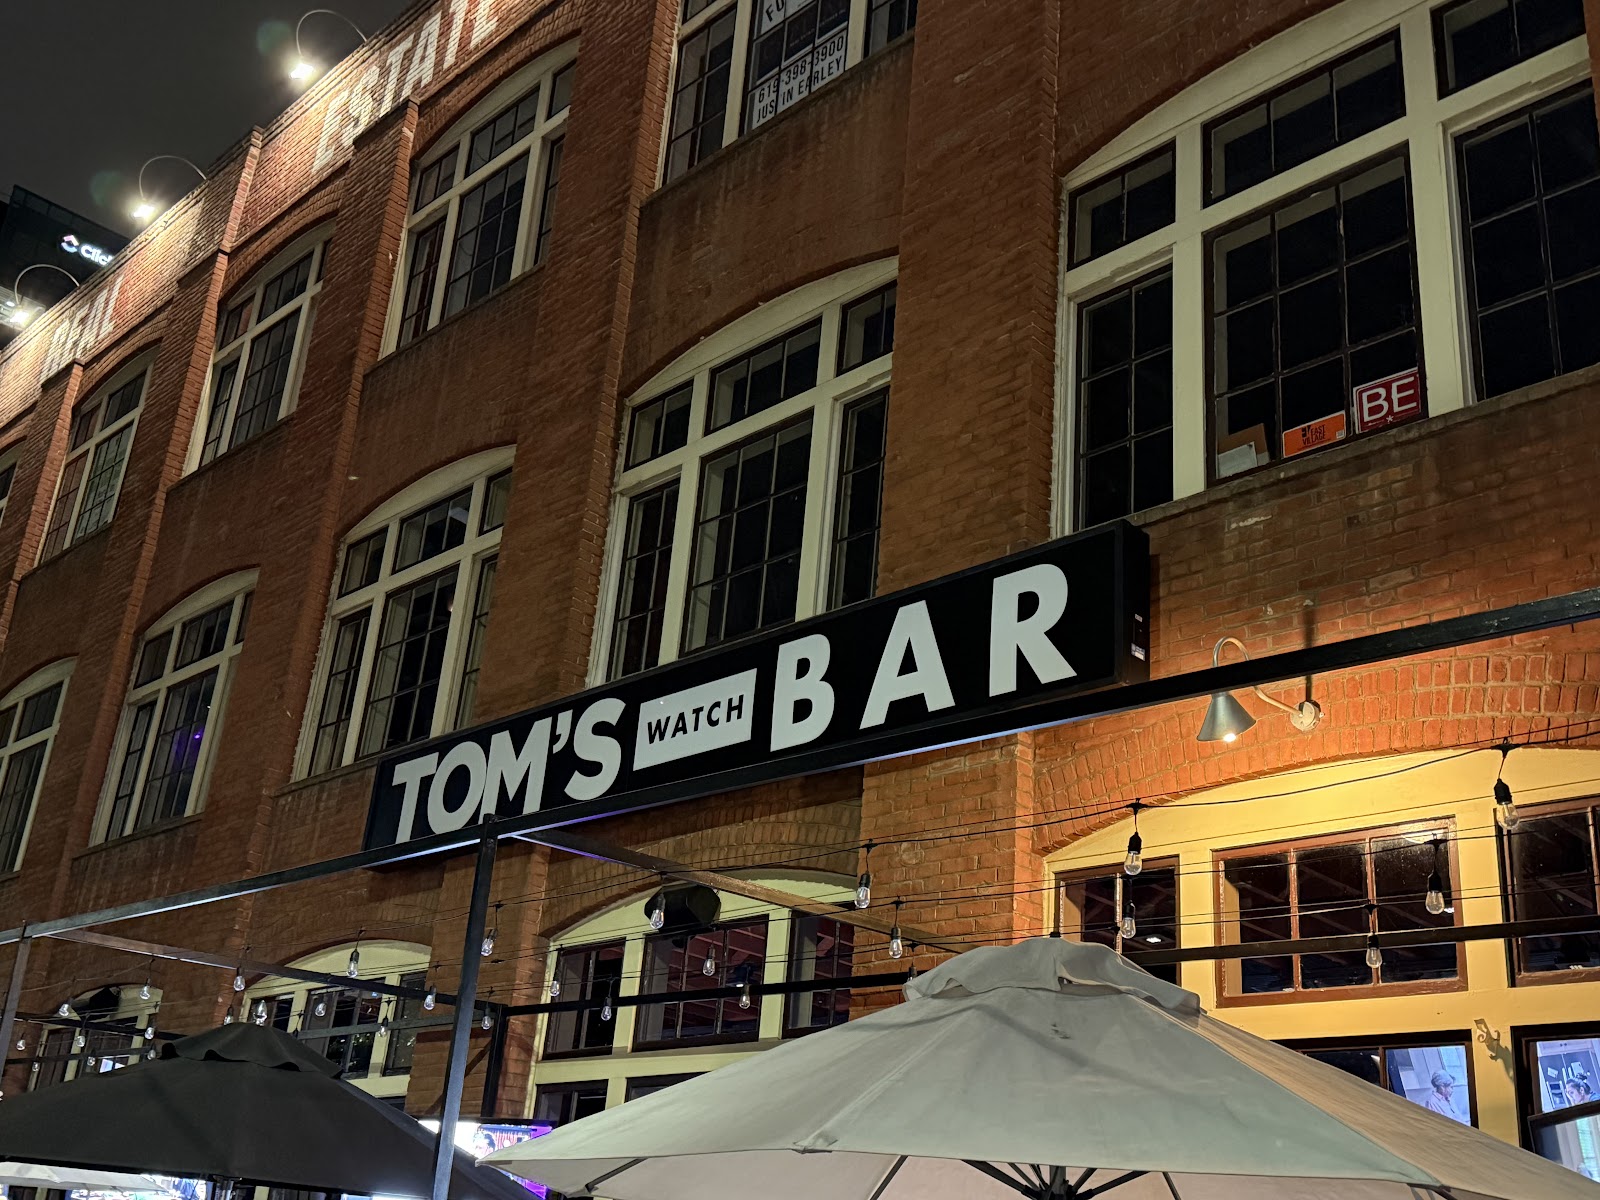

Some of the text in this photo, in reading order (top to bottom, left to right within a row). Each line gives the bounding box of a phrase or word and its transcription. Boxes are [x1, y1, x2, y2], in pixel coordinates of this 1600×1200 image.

[757, 88, 794, 123] JUSIN
[1362, 376, 1418, 422] BE
[1310, 424, 1325, 436] EAST
[392, 563, 1077, 844] TOM'S WATCH BAR
